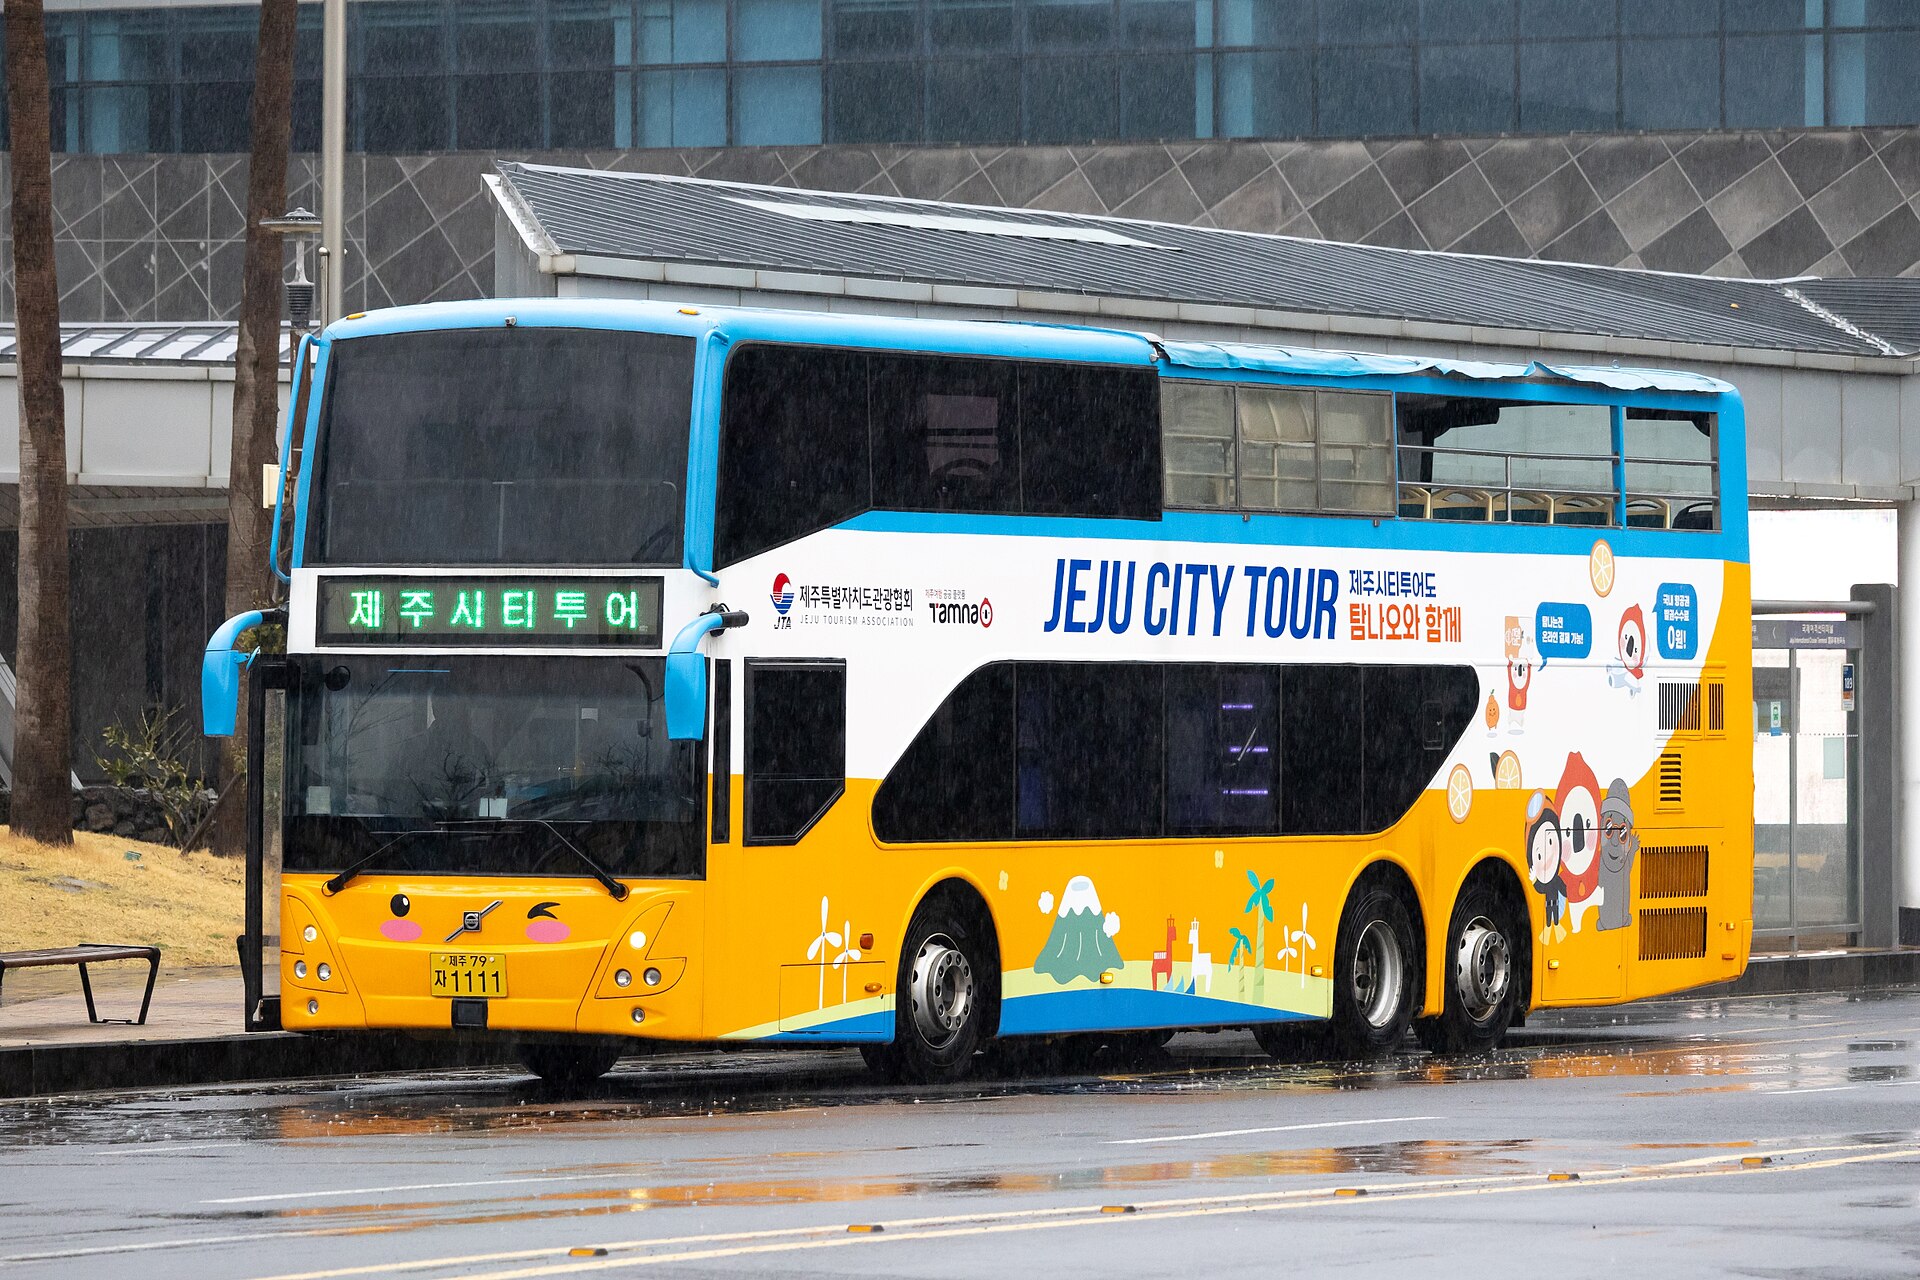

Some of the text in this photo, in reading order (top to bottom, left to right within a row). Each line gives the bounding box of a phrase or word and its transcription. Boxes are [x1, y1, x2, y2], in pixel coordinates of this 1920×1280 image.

[1349, 569, 1437, 598] 제주시티투어도
[349, 590, 638, 628] 제주시티투어
[800, 585, 913, 611] 제주특별자치도관광협회
[1043, 558, 1339, 640] JEJU CITY TOUR
[774, 616, 791, 629] JTA
[800, 615, 914, 627] JEJU TOURISM ASSOCIATION
[1349, 603, 1420, 641] 탐나오와
[1424, 603, 1461, 643] 함께
[1542, 631, 1558, 643] 온라인
[1667, 625, 1687, 650] 0원!
[449, 955, 487, 967] 제주 79
